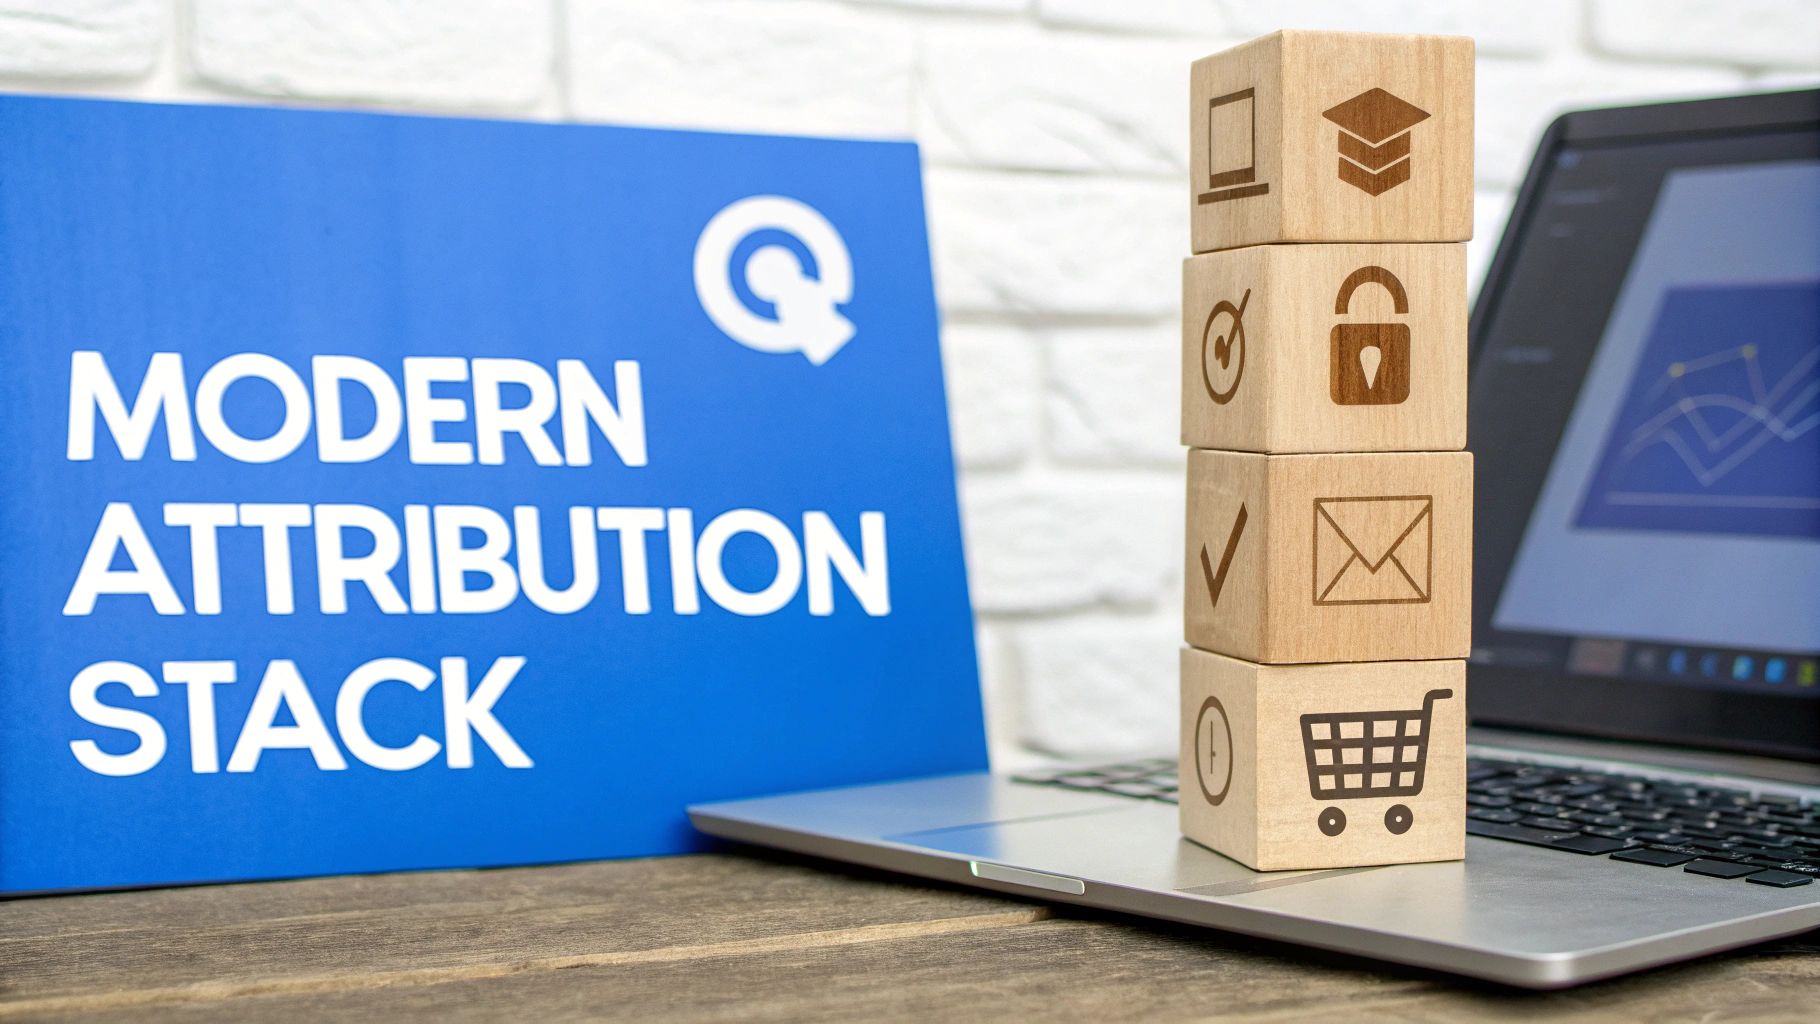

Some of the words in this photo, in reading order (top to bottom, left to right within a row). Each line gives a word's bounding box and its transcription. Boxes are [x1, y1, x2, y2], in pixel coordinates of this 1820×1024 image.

[66, 350, 647, 467] MODERN
[62, 501, 891, 617] ATTRIBUTION
[69, 655, 534, 777] STACK
